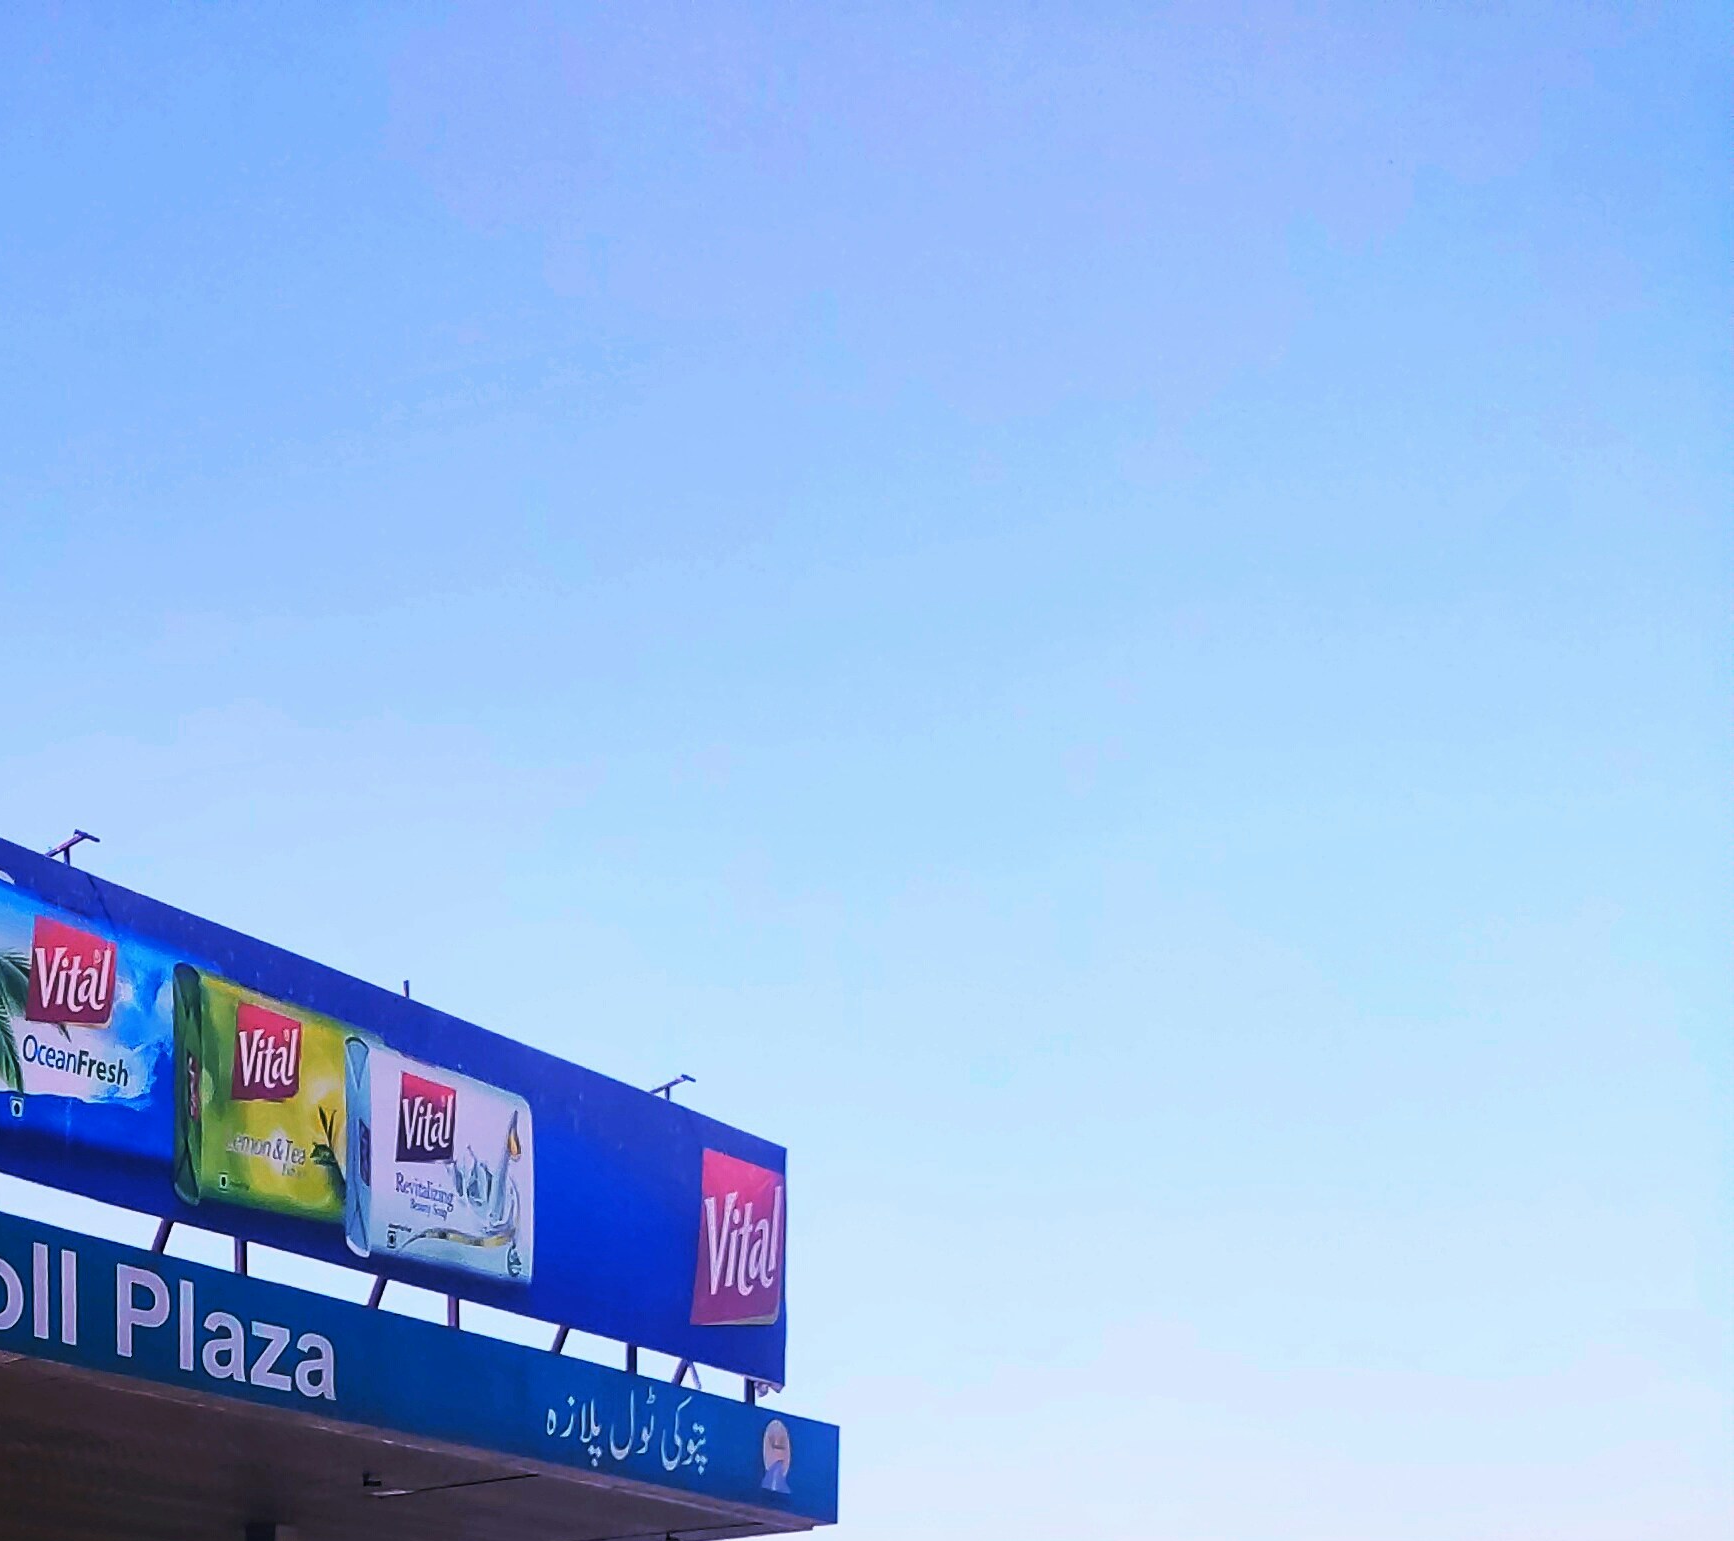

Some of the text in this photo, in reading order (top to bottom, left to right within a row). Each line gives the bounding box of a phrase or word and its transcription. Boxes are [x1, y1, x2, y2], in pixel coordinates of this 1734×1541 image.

[34, 945, 111, 1013] Vital
[22, 1034, 129, 1087] OceanFresh
[238, 1028, 299, 1089] Vital
[402, 1094, 454, 1152] Vital
[704, 1185, 782, 1297] Vital
[116, 1263, 337, 1401] Plaza
[609, 1385, 656, 1460] ٹول
